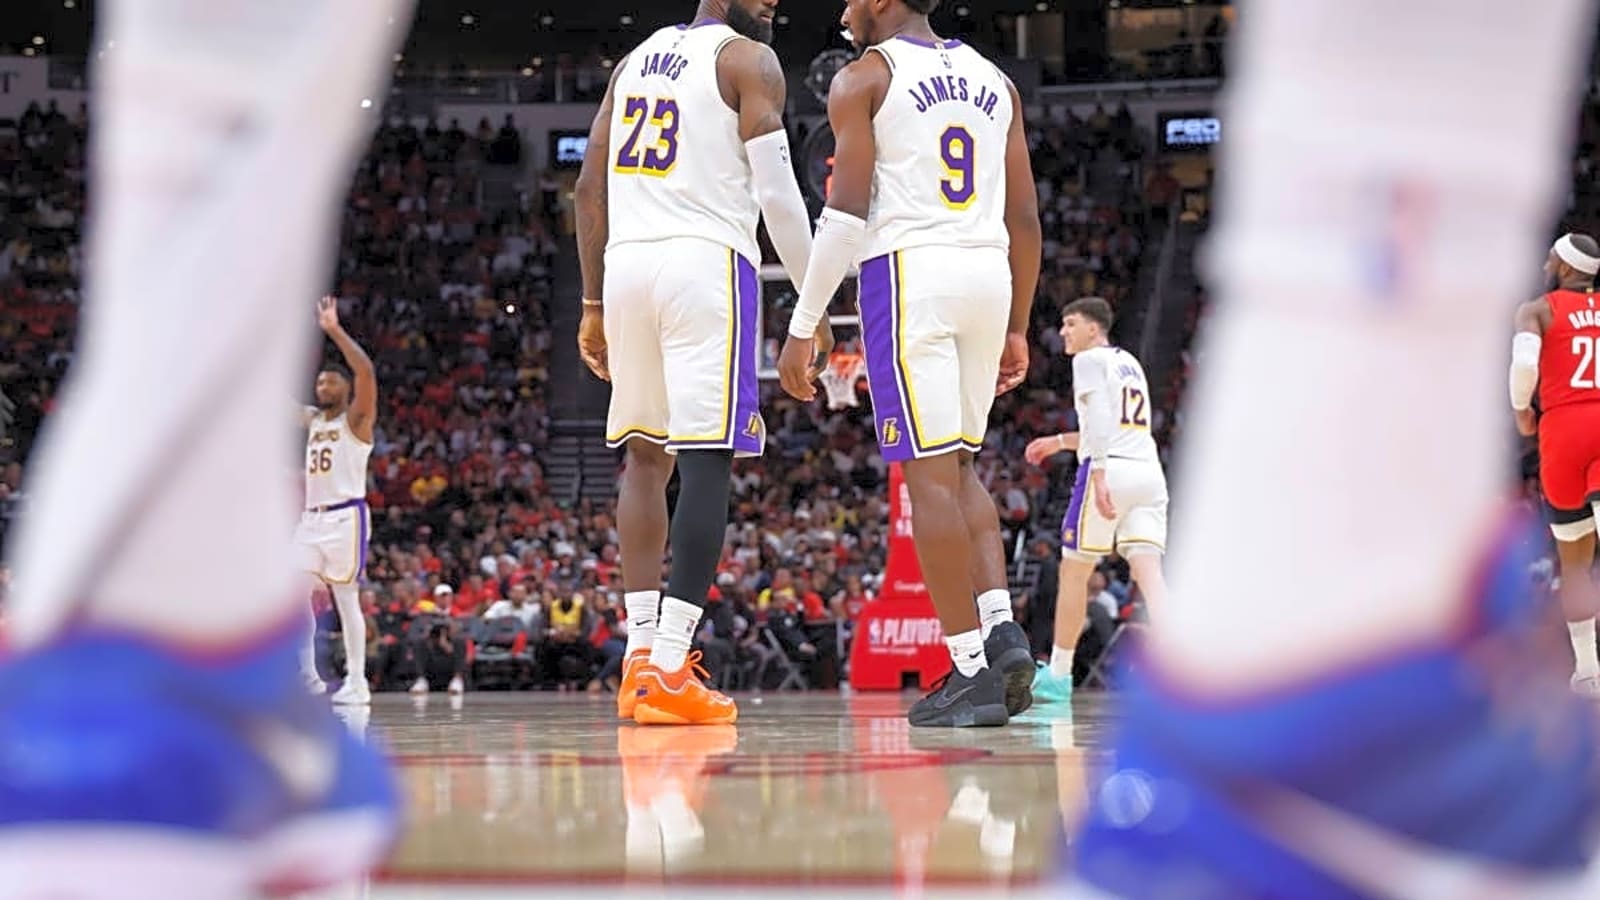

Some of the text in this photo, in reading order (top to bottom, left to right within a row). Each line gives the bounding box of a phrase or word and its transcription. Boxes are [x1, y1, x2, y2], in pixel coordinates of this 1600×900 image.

[640, 52, 688, 81] JAMES
[908, 75, 998, 121] JAMES JR.
[614, 95, 680, 178] 23
[939, 124, 977, 211] 9
[1570, 335, 1600, 389] 2
[1120, 386, 1147, 429] 12
[309, 448, 333, 475] 36
